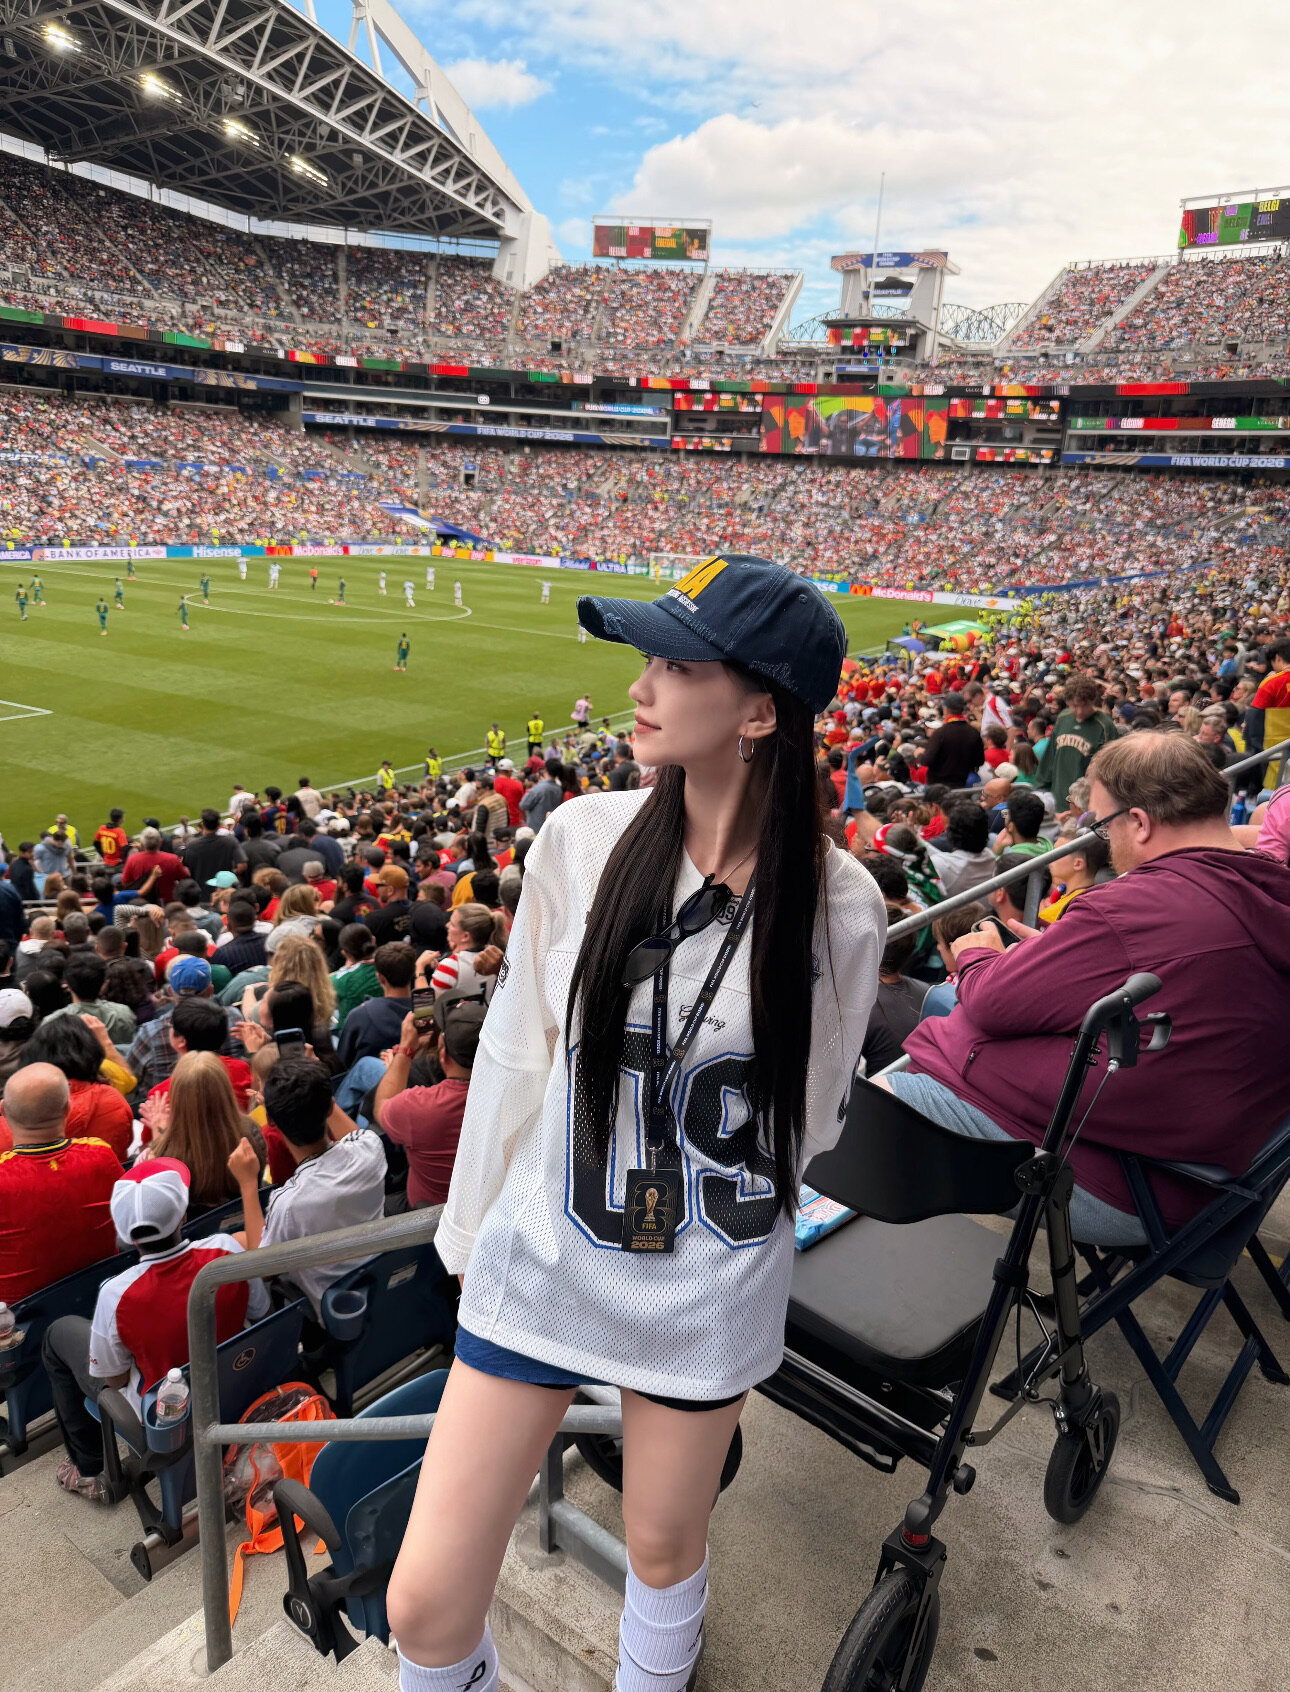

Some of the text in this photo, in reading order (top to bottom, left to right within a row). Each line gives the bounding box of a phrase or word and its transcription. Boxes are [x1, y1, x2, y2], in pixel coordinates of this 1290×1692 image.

[110, 361, 167, 377] SEATTLE
[314, 414, 376, 427] SEATTLE
[477, 427, 495, 436] FIFA
[497, 428, 526, 438] WORLD
[527, 430, 544, 439] CUP
[1170, 456, 1285, 468] FIFA WORLD CUP 2026
[50, 547, 151, 559] BANK OF AMERICA
[193, 545, 242, 558] Hisense
[872, 586, 932, 603] McDonald's
[1056, 733, 1092, 758] SEATTLE
[642, 1222, 657, 1230] FIFA
[631, 1240, 665, 1250] 2026
